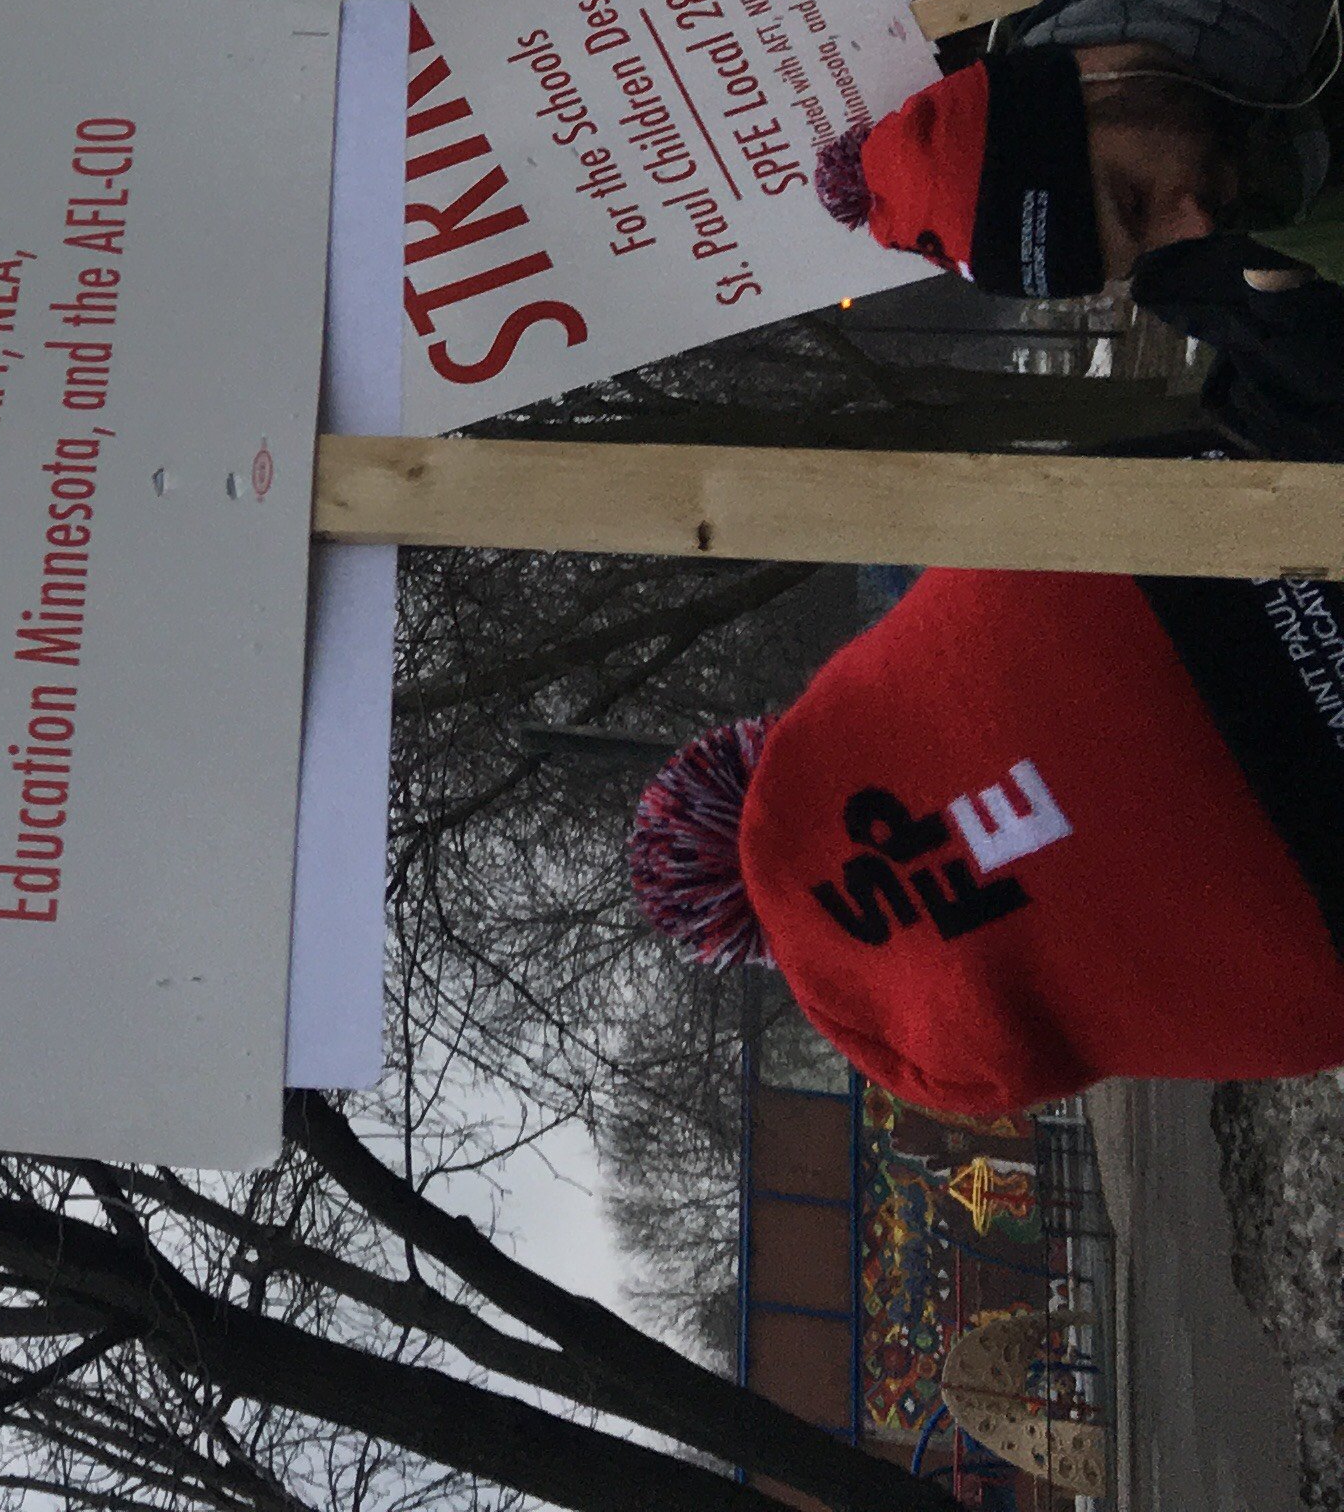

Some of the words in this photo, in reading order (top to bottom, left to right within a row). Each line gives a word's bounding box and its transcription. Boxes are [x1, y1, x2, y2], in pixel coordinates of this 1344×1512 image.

[755, 15, 793, 55] AFT,
[507, 28, 597, 146] Schools
[686, 31, 768, 117] Local
[772, 55, 811, 95] with
[611, 56, 698, 184] Children
[734, 117, 810, 197] SPFE
[789, 95, 837, 149] liated
[63, 117, 136, 255] AFL-CIO
[404, 6, 589, 385] STRI
[577, 148, 627, 199] the
[609, 204, 655, 255] For
[664, 187, 738, 261] Paul
[50, 267, 121, 327] the
[714, 261, 762, 305] St.
[44, 340, 113, 411] and
[12, 427, 113, 666] Minnesota,
[1263, 586, 1318, 661] PAUL
